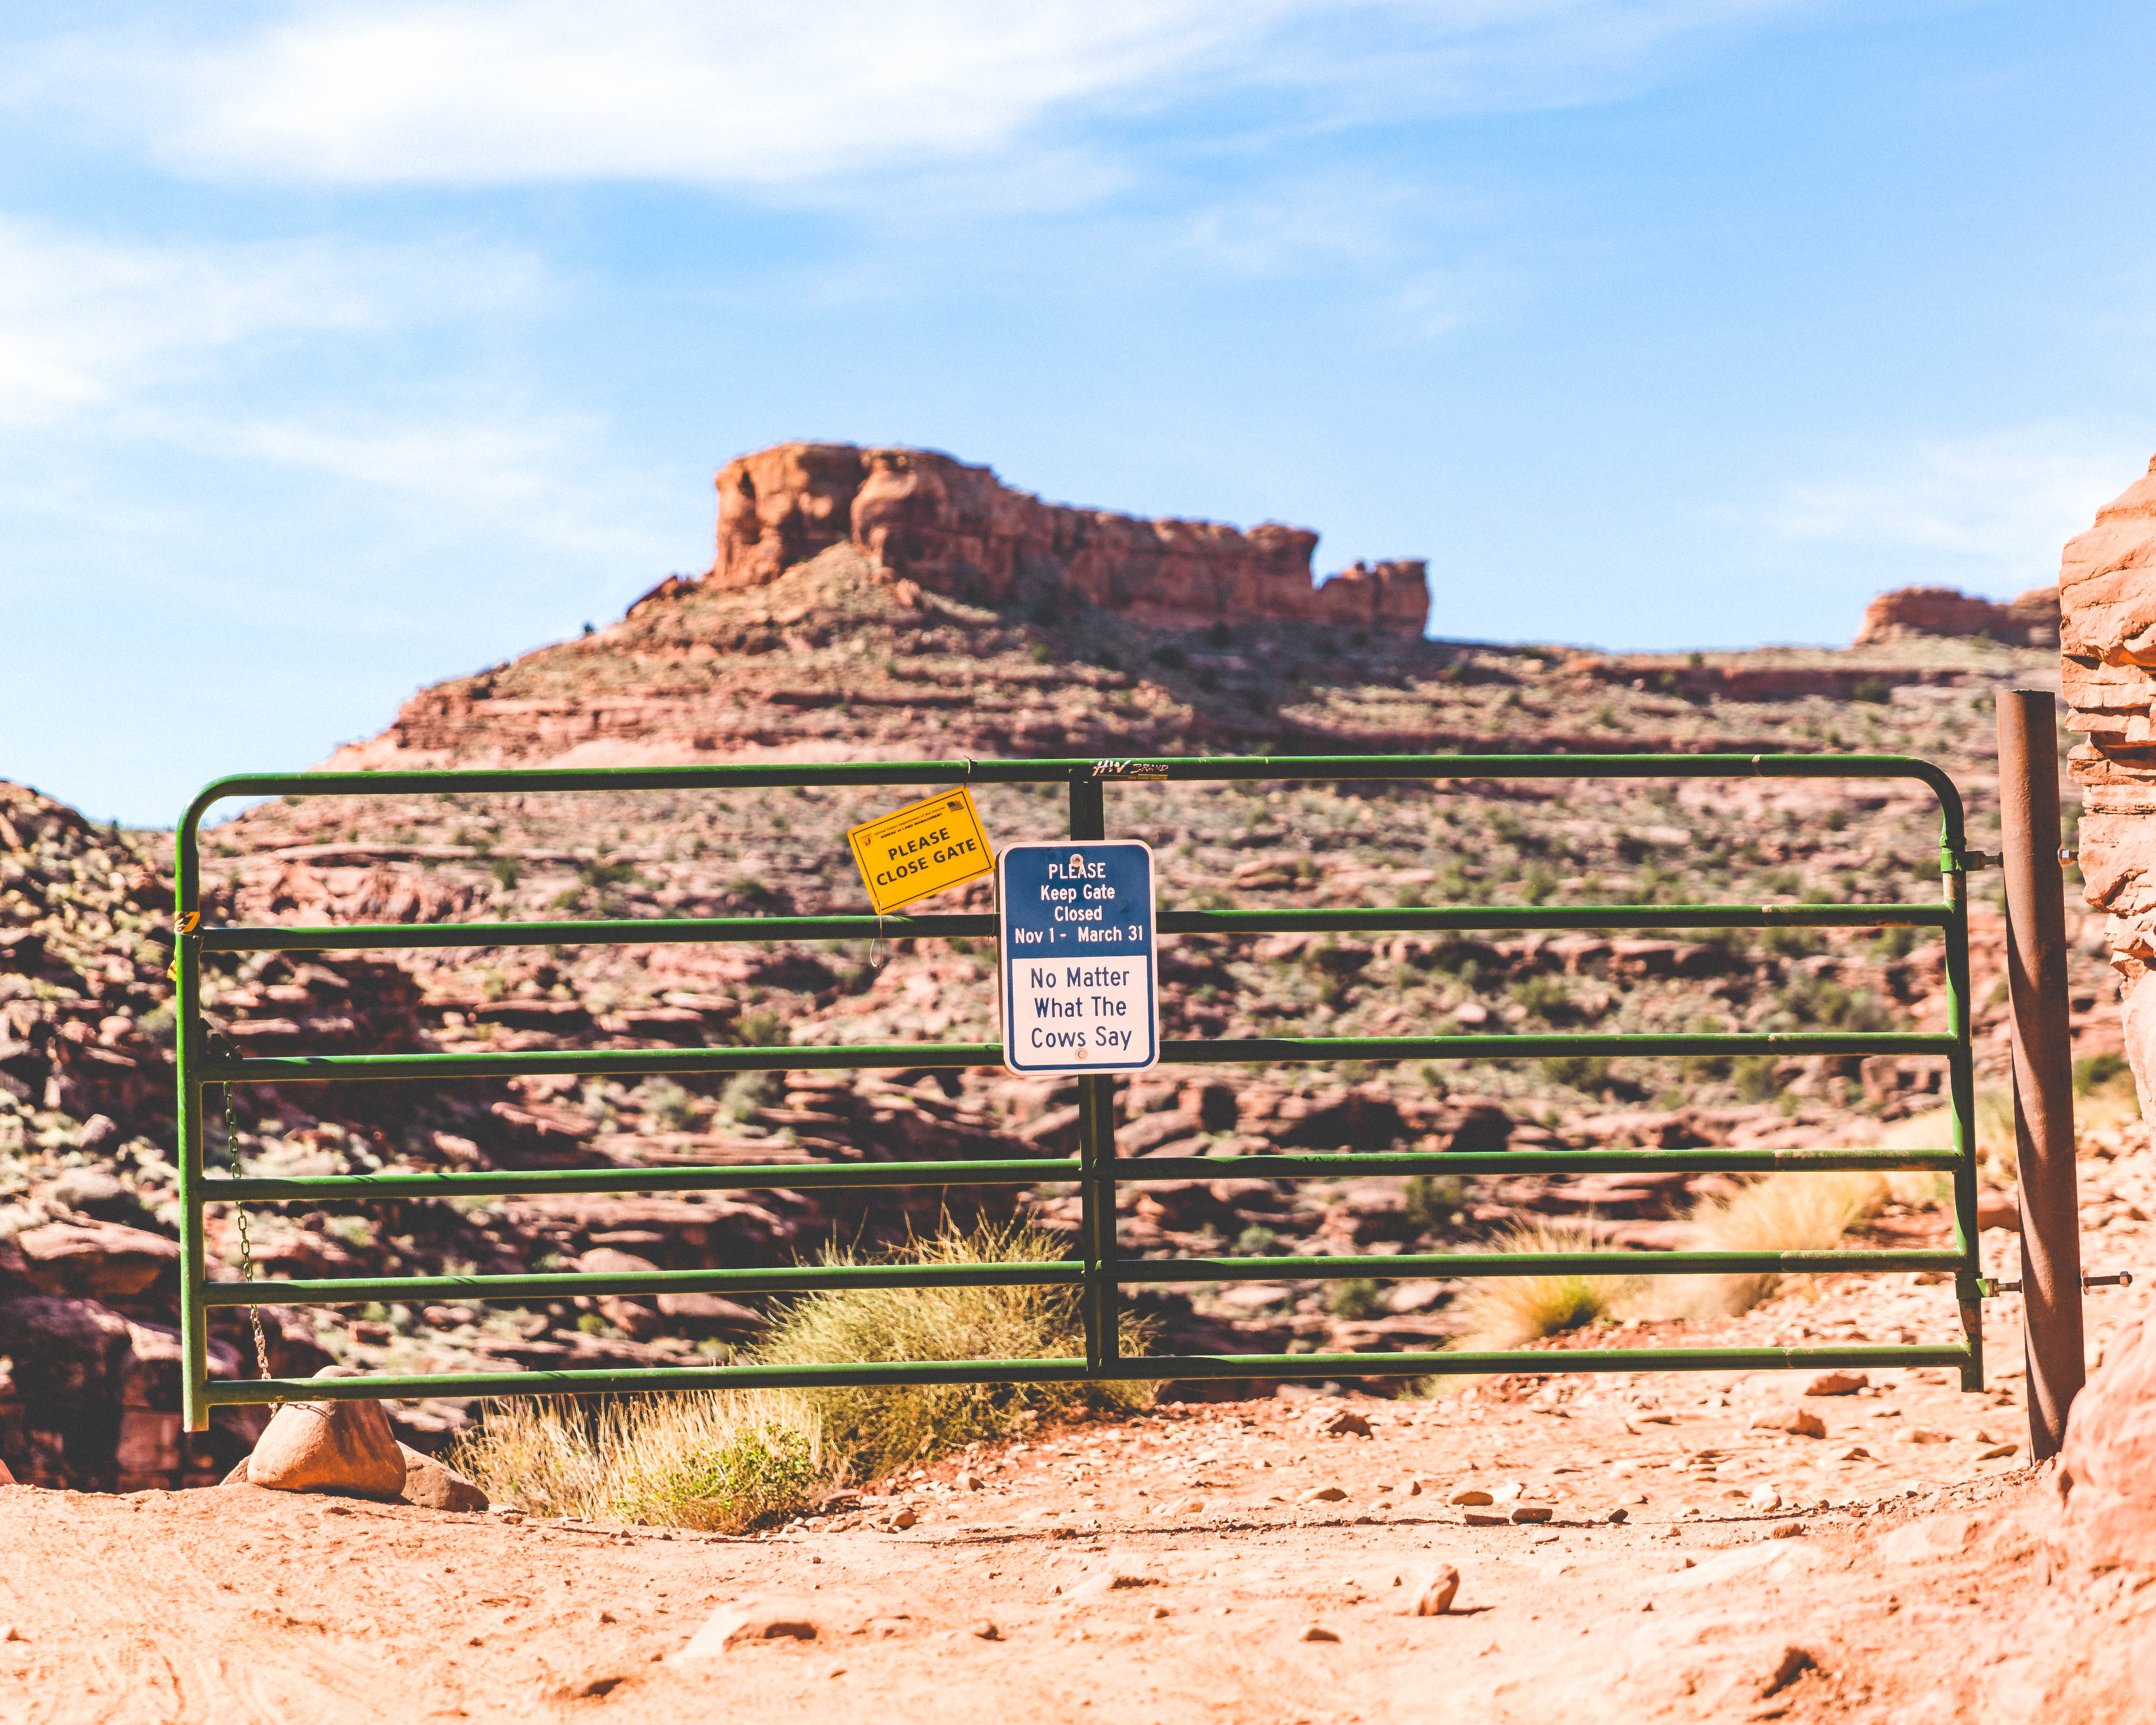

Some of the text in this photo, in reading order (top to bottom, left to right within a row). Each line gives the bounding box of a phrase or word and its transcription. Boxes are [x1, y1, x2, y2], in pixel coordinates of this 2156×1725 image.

[914, 812, 942, 825] MANAGEMENT
[888, 827, 950, 861] PLEASE
[877, 838, 977, 886] CLOSE GATE
[1048, 863, 1106, 879] PLEASE
[1040, 884, 1116, 903] Keep Gate
[1054, 905, 1103, 922] Closed
[1015, 928, 1044, 944] Nov
[1049, 927, 1054, 943] 1
[1078, 926, 1123, 942] March
[1128, 924, 1143, 941] 31
[1031, 966, 1130, 989] No Matter
[1034, 996, 1127, 1018] What The
[1031, 1026, 1132, 1051] Cows Say
